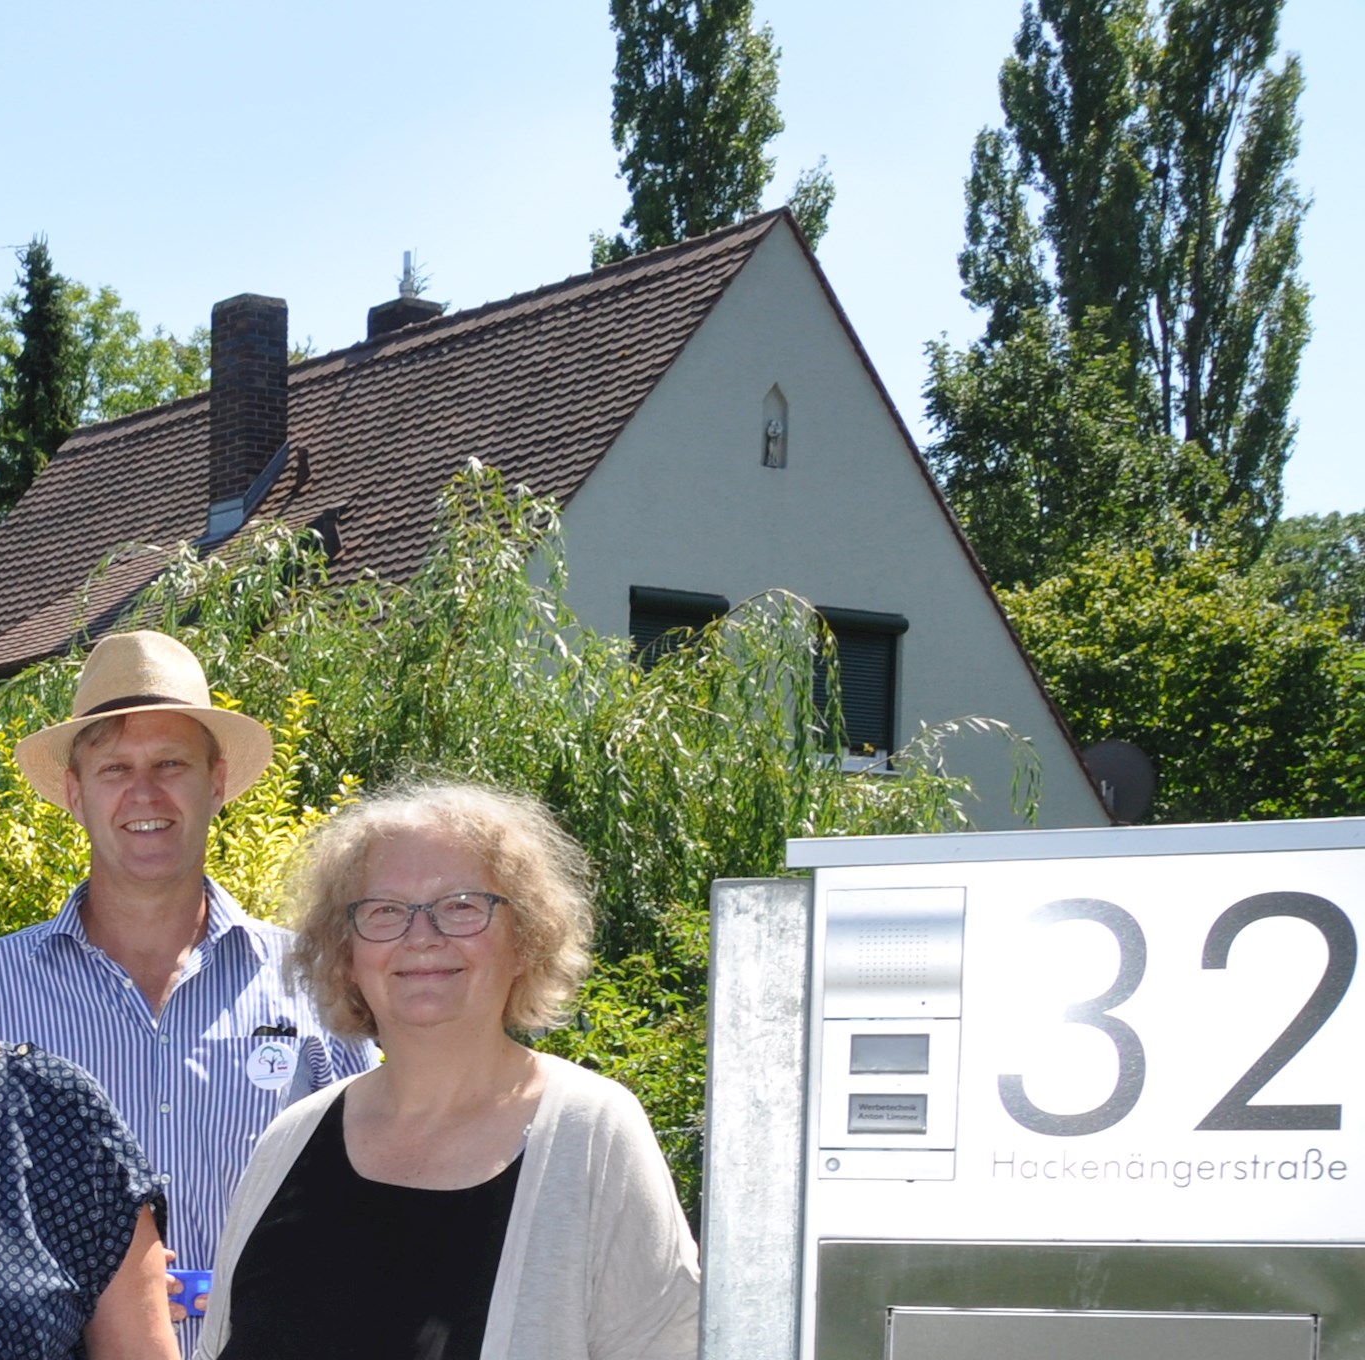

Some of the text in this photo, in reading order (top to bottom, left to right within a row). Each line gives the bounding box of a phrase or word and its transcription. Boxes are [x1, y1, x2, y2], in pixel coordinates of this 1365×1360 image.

[997, 890, 1358, 1137] 32
[857, 1103, 917, 1111] Werbetechnik
[857, 1112, 919, 1121] Anton Limmer
[992, 1148, 1348, 1188] Hackenängerstraße
